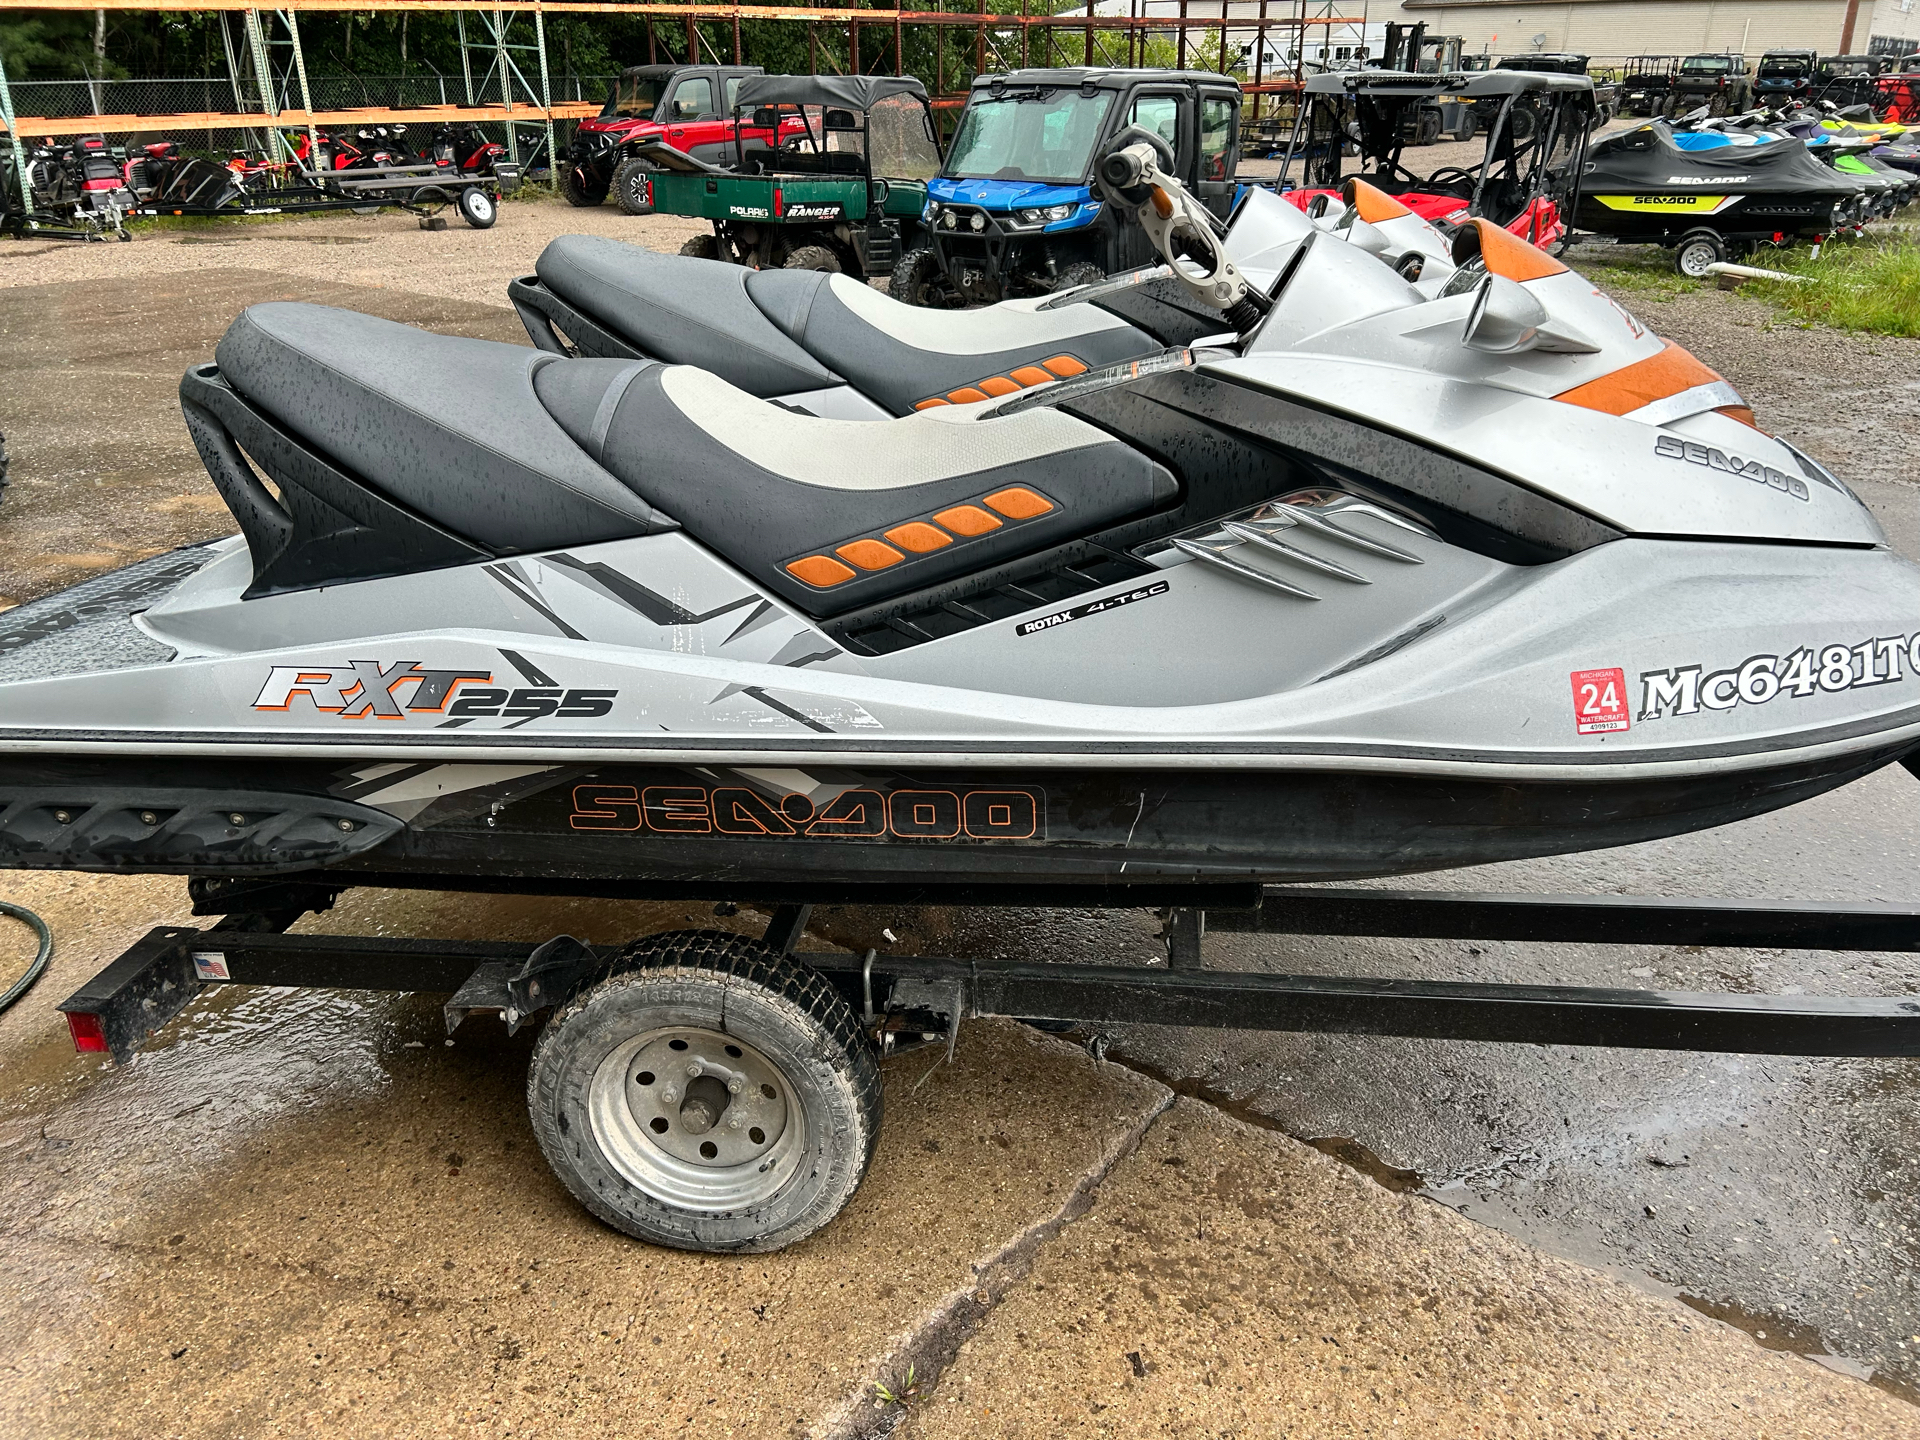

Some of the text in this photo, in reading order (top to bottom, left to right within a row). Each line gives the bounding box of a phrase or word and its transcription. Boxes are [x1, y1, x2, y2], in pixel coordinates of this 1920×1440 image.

[787, 207, 840, 217] RANGER
[1024, 583, 1166, 634] ROTAX 4-TEC
[1580, 671, 1614, 680] MICHIGAN
[250, 660, 619, 720] RXT 255
[1580, 682, 1620, 715] 24
[1580, 713, 1625, 724] WATERCRAFT
